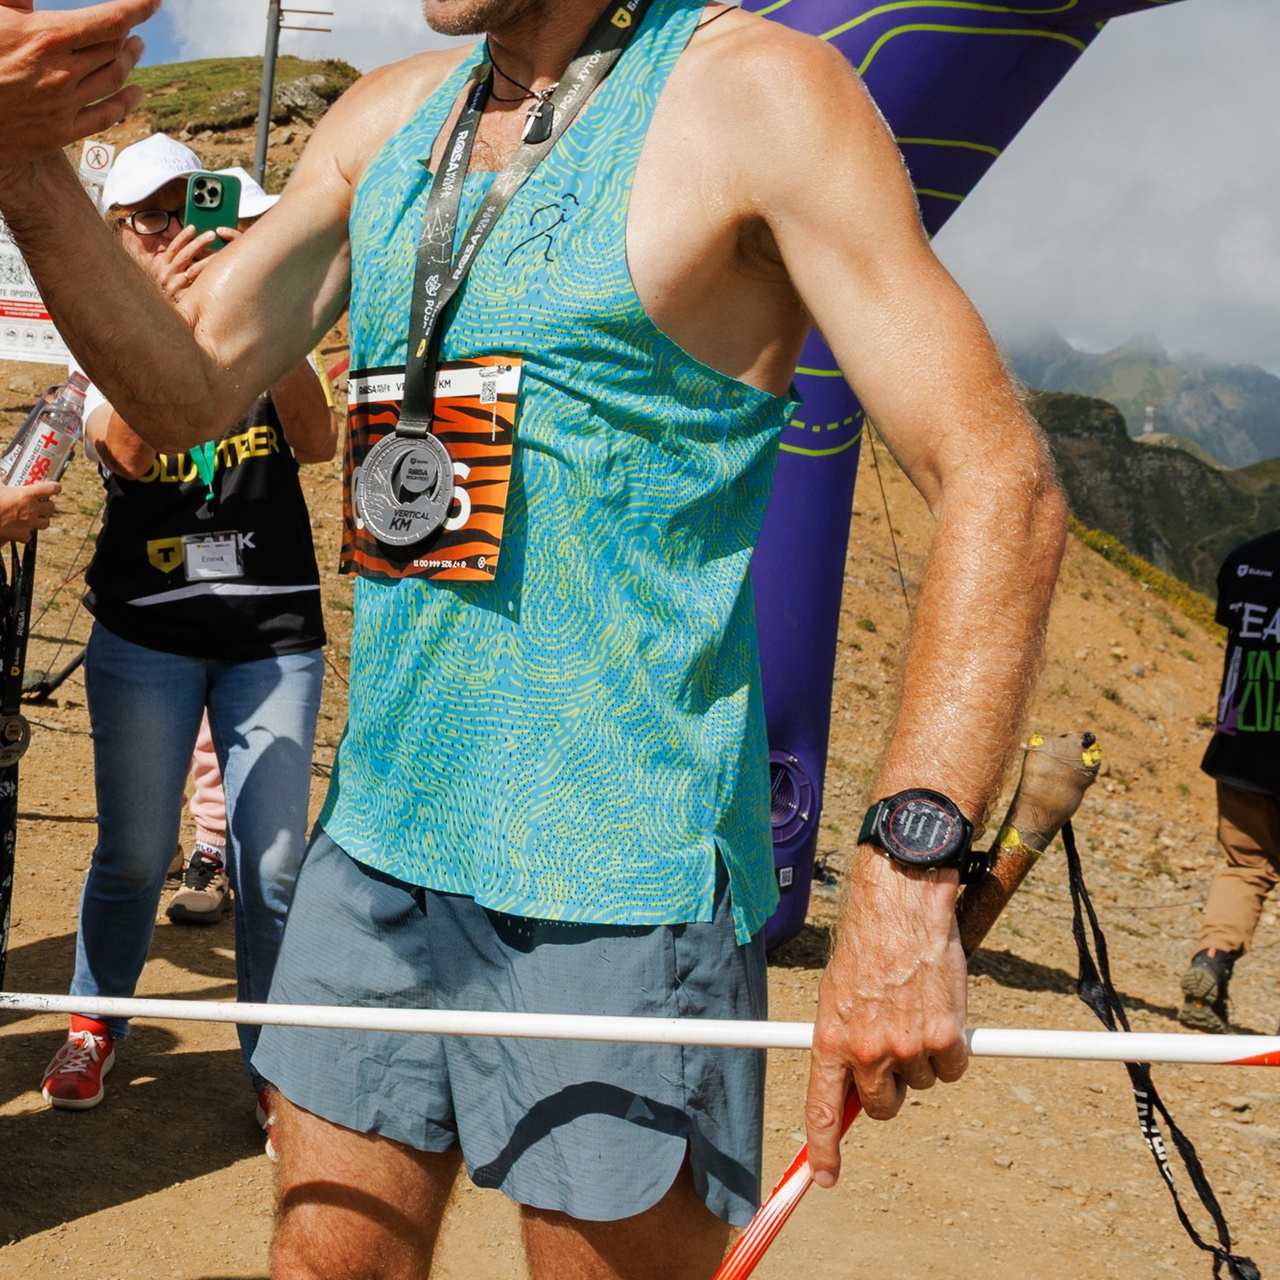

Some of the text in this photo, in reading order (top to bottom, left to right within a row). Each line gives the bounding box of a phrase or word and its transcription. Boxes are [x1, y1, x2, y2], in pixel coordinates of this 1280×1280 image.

[560, 49, 602, 110] РОЗА ХУТОР
[10, 289, 41, 299] ПРОПУС
[438, 379, 452, 389] KM
[394, 509, 430, 520] VERTICAL
[389, 517, 412, 531] KM
[201, 554, 224, 563] Елена
